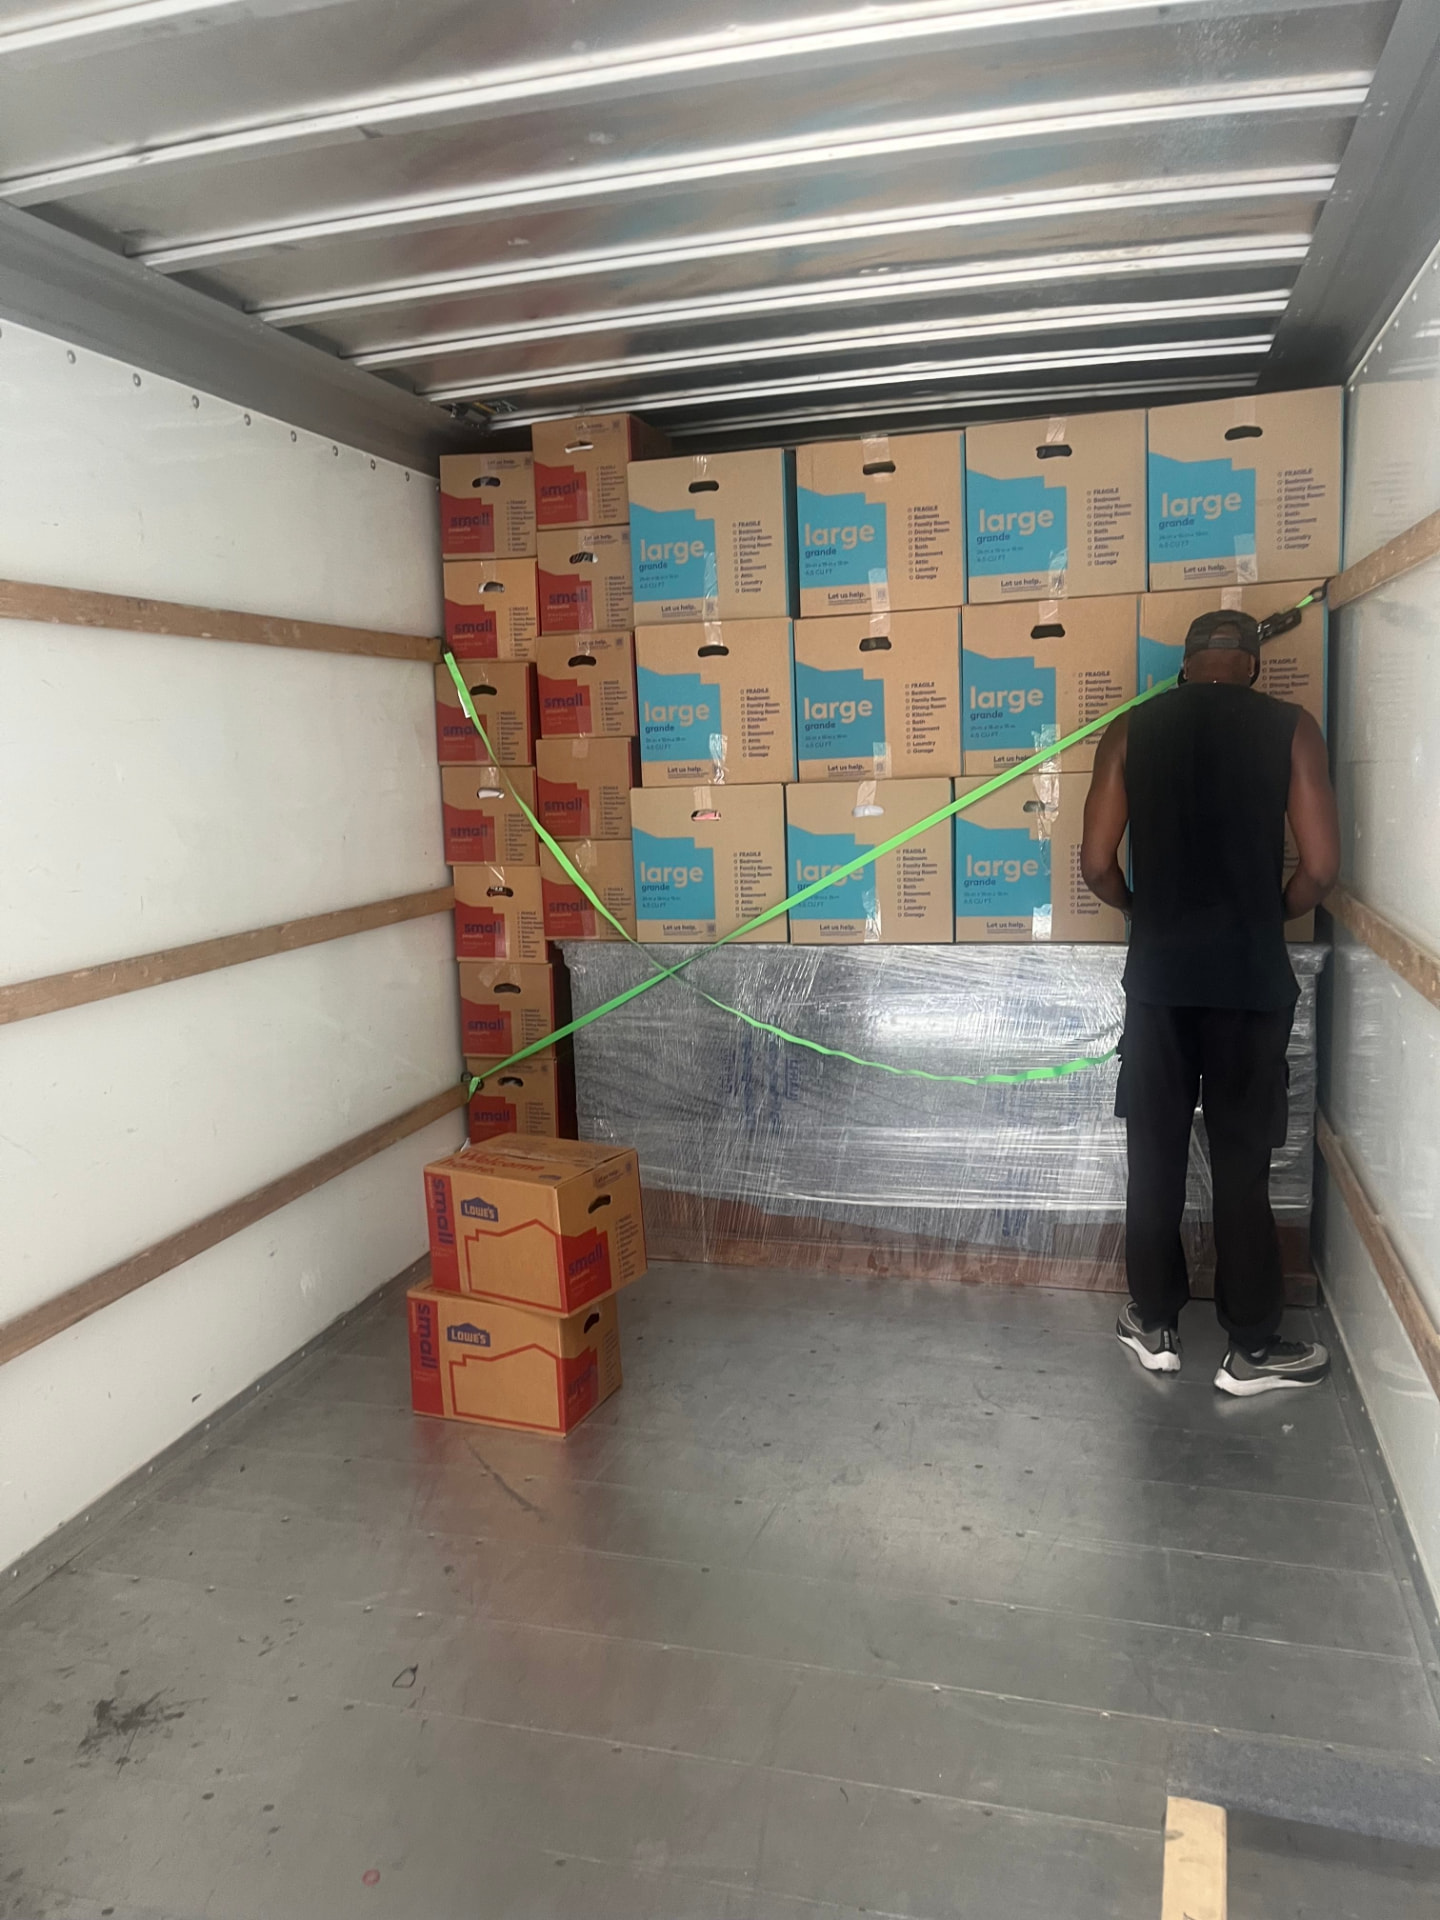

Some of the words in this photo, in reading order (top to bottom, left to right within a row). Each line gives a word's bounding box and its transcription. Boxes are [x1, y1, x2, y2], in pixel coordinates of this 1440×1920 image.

[540, 481, 581, 497] small
[1162, 492, 1241, 520] large
[450, 513, 490, 527] small
[979, 509, 1054, 536] large
[1158, 517, 1194, 530] grande
[804, 523, 874, 550] large
[977, 533, 1010, 545] grande
[640, 539, 705, 565] large
[805, 547, 836, 558] grande
[639, 562, 667, 572] grande
[548, 588, 588, 604] small
[454, 619, 492, 635] small
[544, 694, 583, 707] small
[970, 686, 1044, 713] large
[645, 702, 710, 727] large
[804, 697, 872, 724] large
[970, 710, 1003, 720] grande
[646, 724, 674, 734] grande
[805, 721, 835, 731] grande
[544, 799, 582, 812] small
[451, 824, 488, 837] small
[640, 861, 704, 888] large
[966, 854, 1038, 882] large
[642, 884, 670, 892] grande
[964, 878, 996, 887] grande
[550, 899, 588, 912] small
[464, 921, 501, 934] small
[467, 1019, 504, 1031] small
[474, 1110, 510, 1122] small
[434, 1179, 454, 1245] small
[568, 1242, 603, 1277] small
[417, 1303, 437, 1369] small
